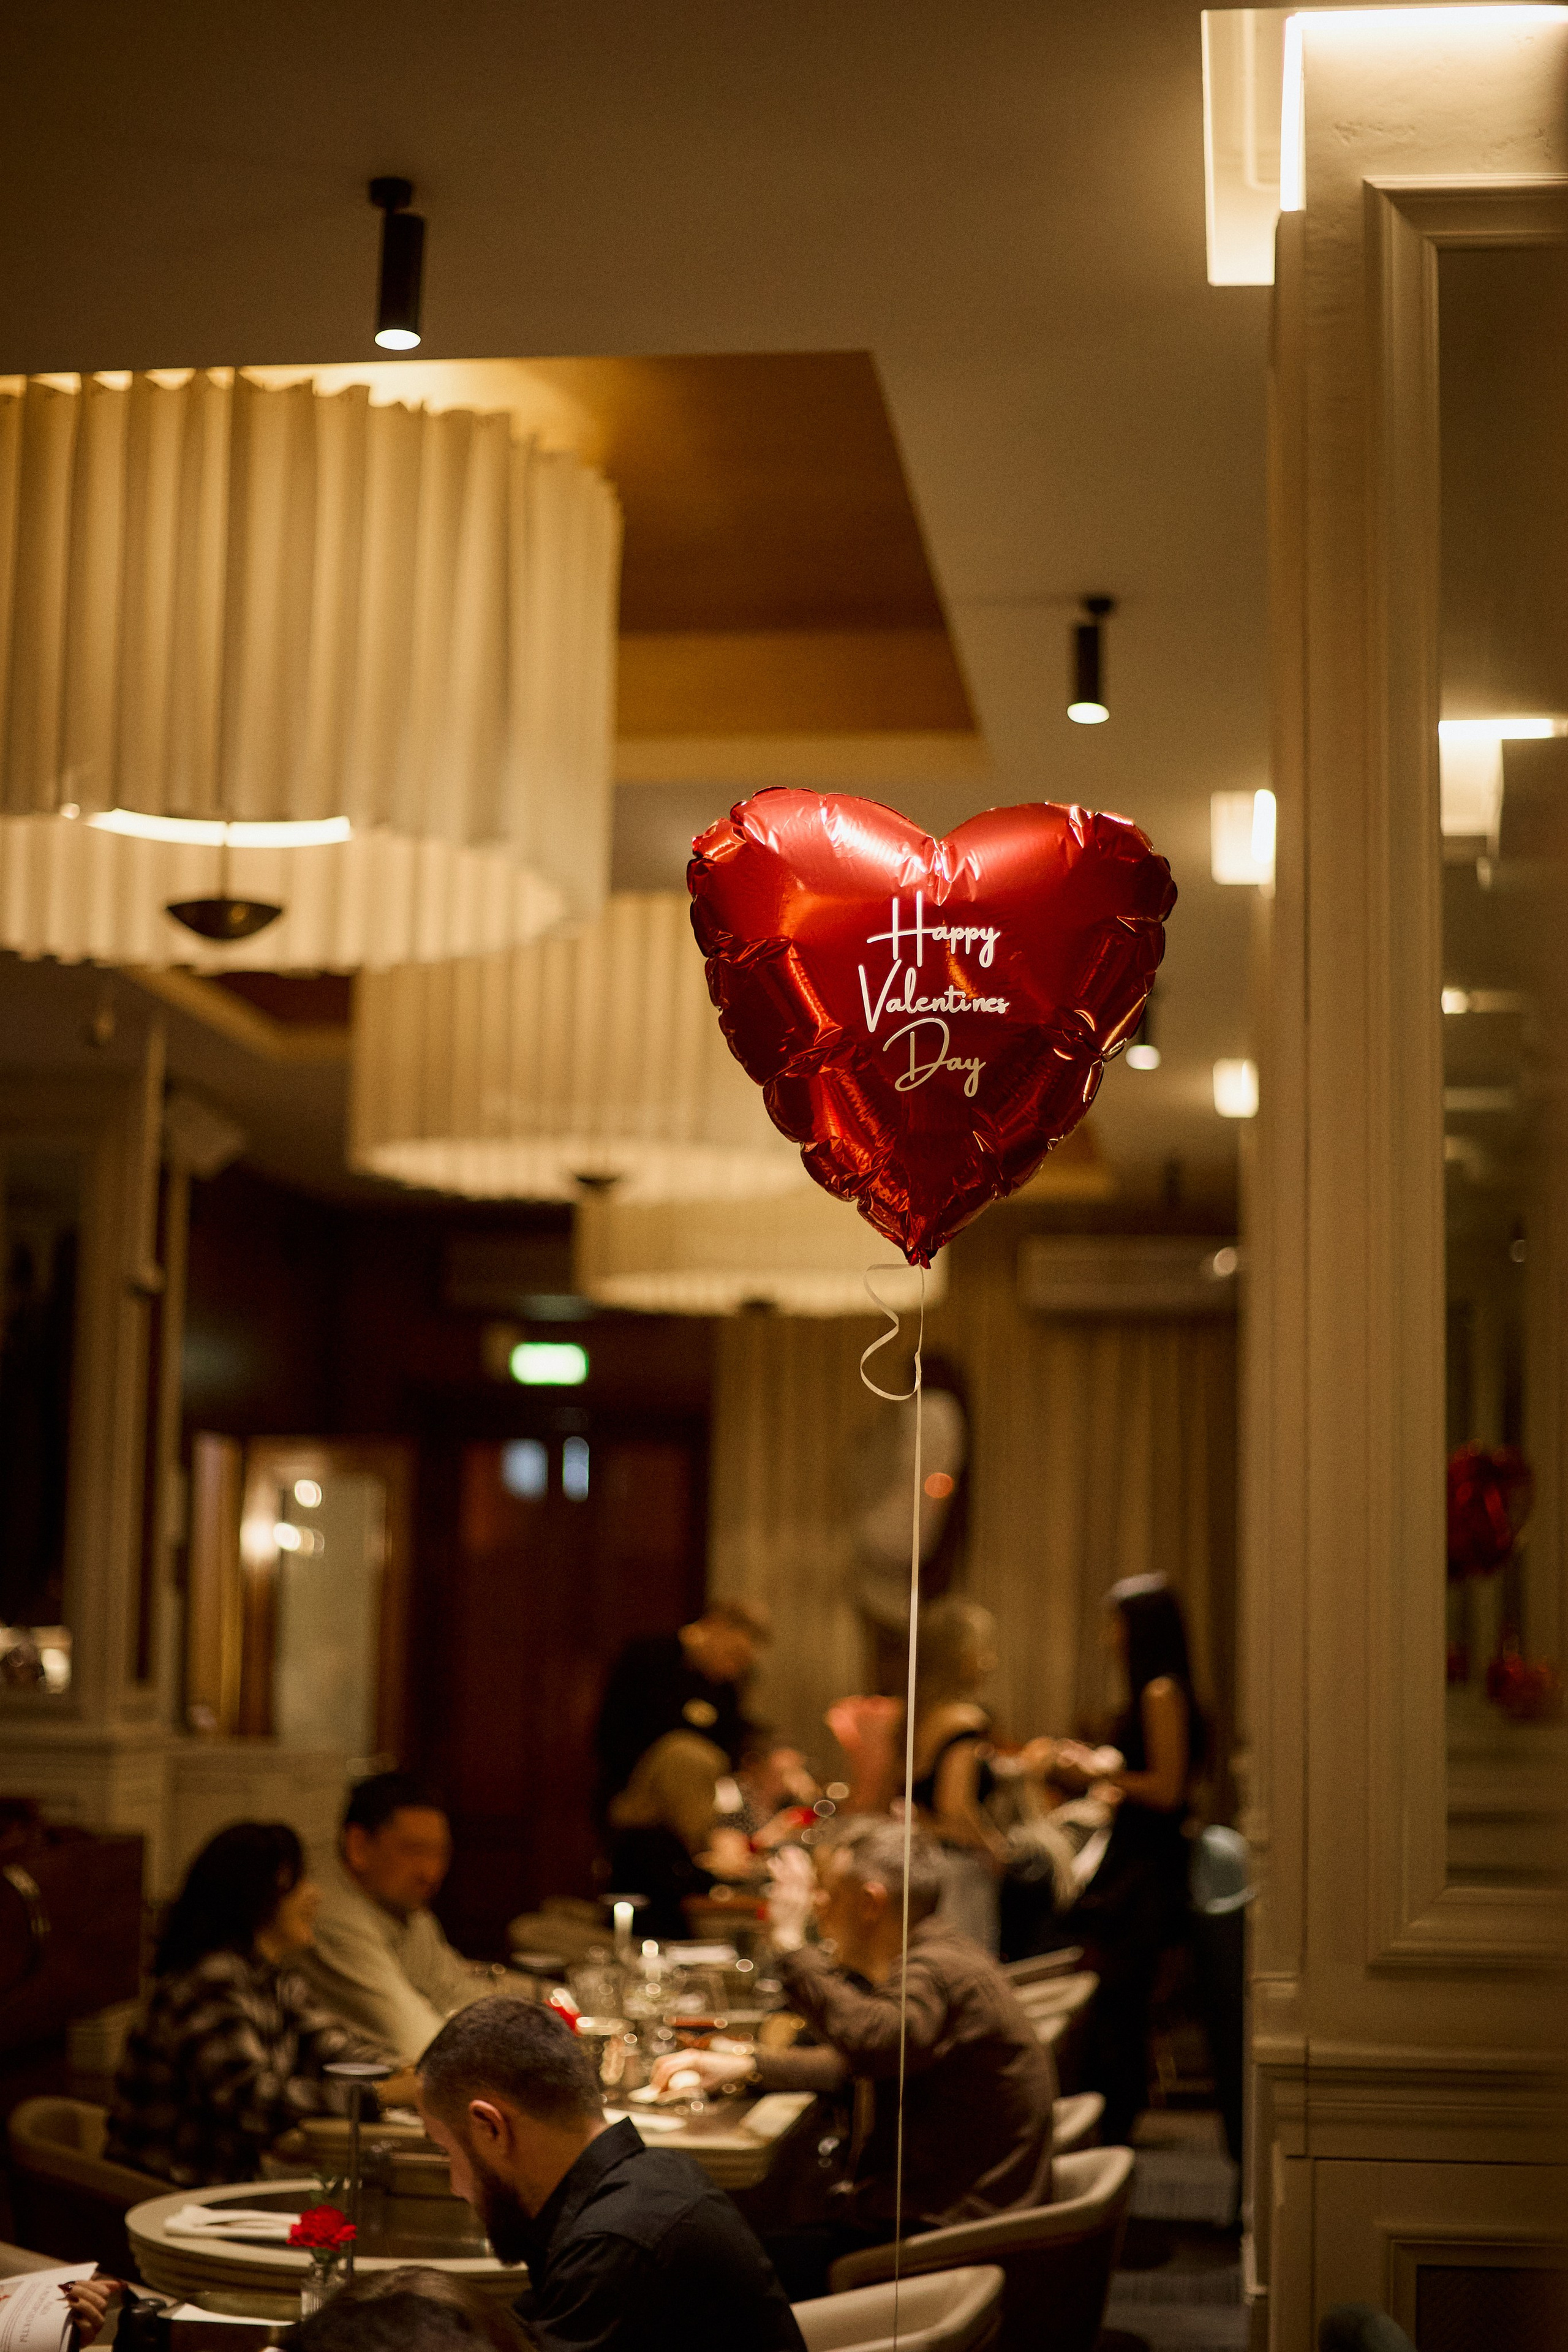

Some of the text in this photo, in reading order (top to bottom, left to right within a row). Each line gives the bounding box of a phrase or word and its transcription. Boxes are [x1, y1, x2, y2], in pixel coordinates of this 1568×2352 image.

[866, 891, 1001, 968] Happy
[858, 959, 1009, 1033] Valentines
[883, 1017, 986, 1098] Day
